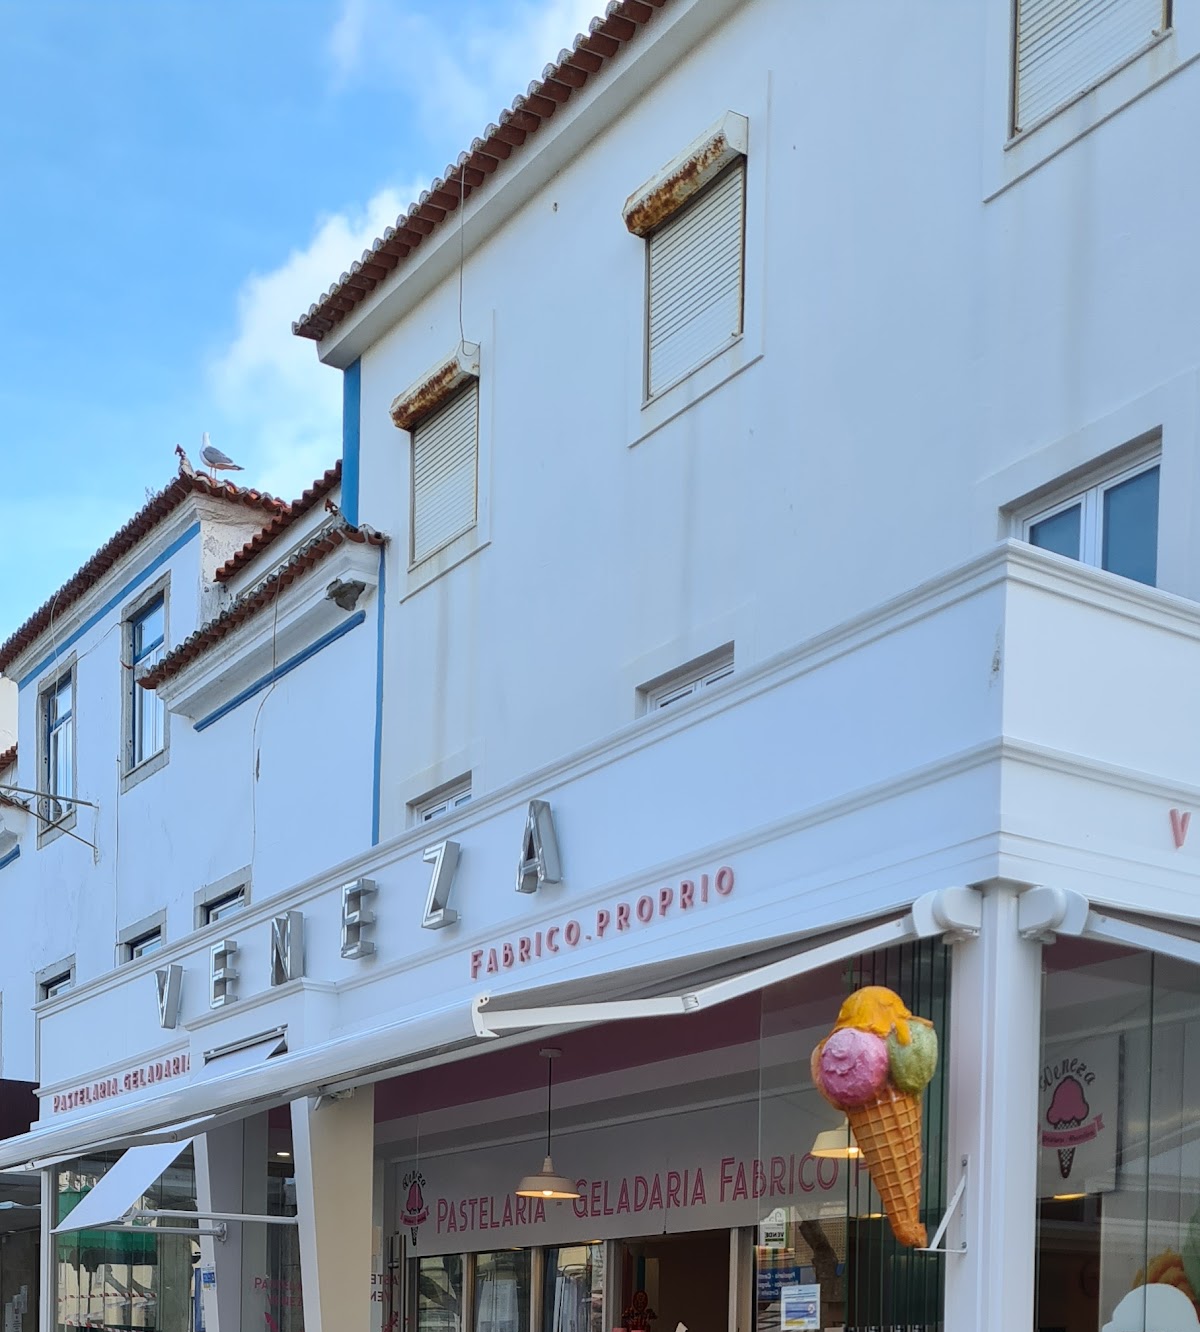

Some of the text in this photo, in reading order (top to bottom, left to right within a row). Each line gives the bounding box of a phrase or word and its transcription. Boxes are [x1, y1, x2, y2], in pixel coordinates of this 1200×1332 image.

[1169, 808, 1191, 849] V
[154, 800, 562, 1029] VENEZA
[572, 1167, 707, 1219] GELADARIA
[719, 1152, 839, 1203] FABRICO
